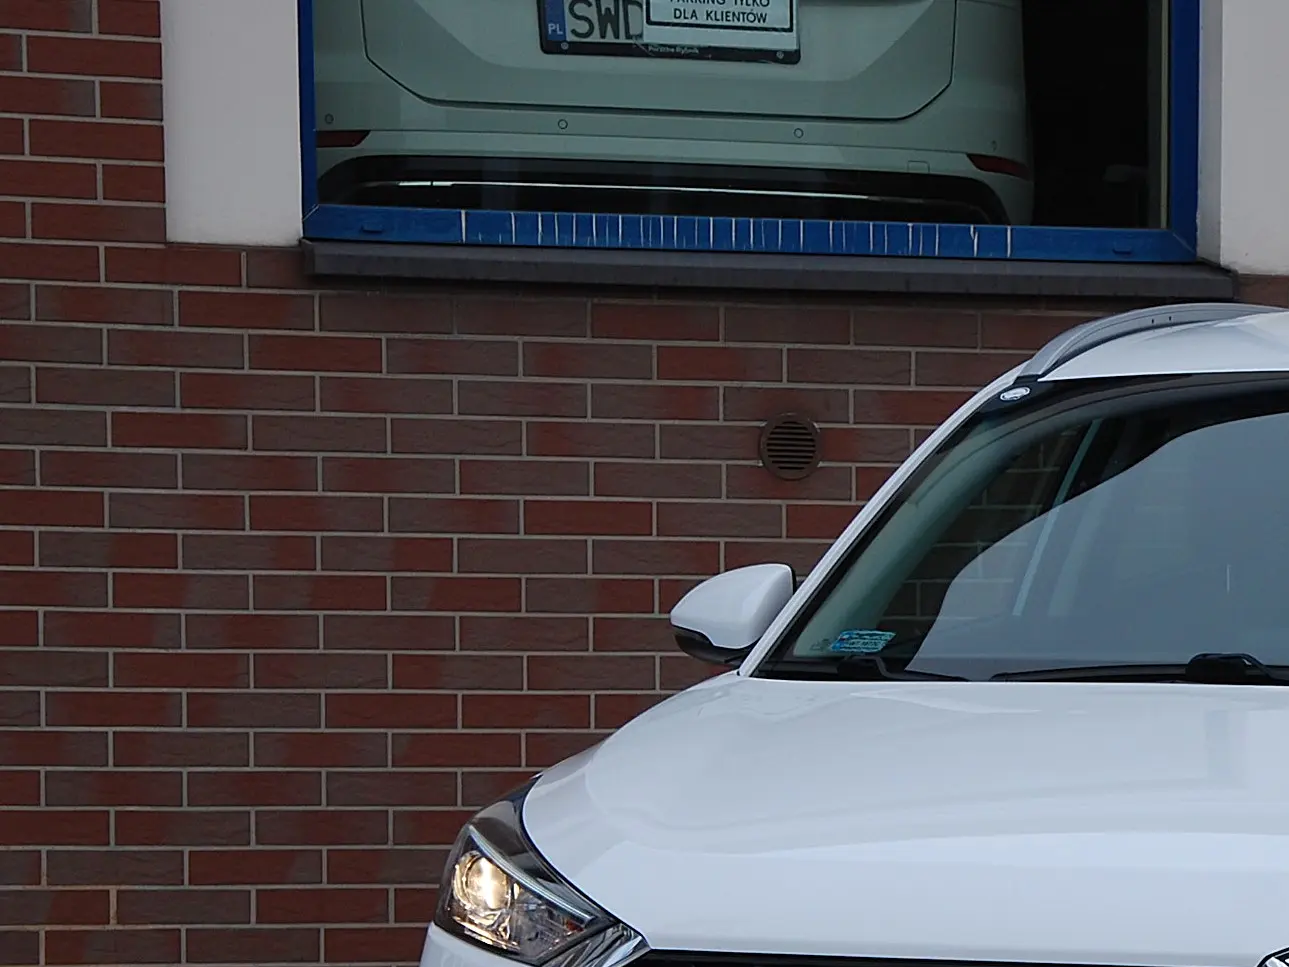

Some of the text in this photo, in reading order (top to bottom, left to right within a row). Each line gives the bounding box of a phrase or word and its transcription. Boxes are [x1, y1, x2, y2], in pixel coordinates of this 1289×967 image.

[673, 8, 768, 24] DLA KLIENTÓW
[547, 23, 564, 35] PL
